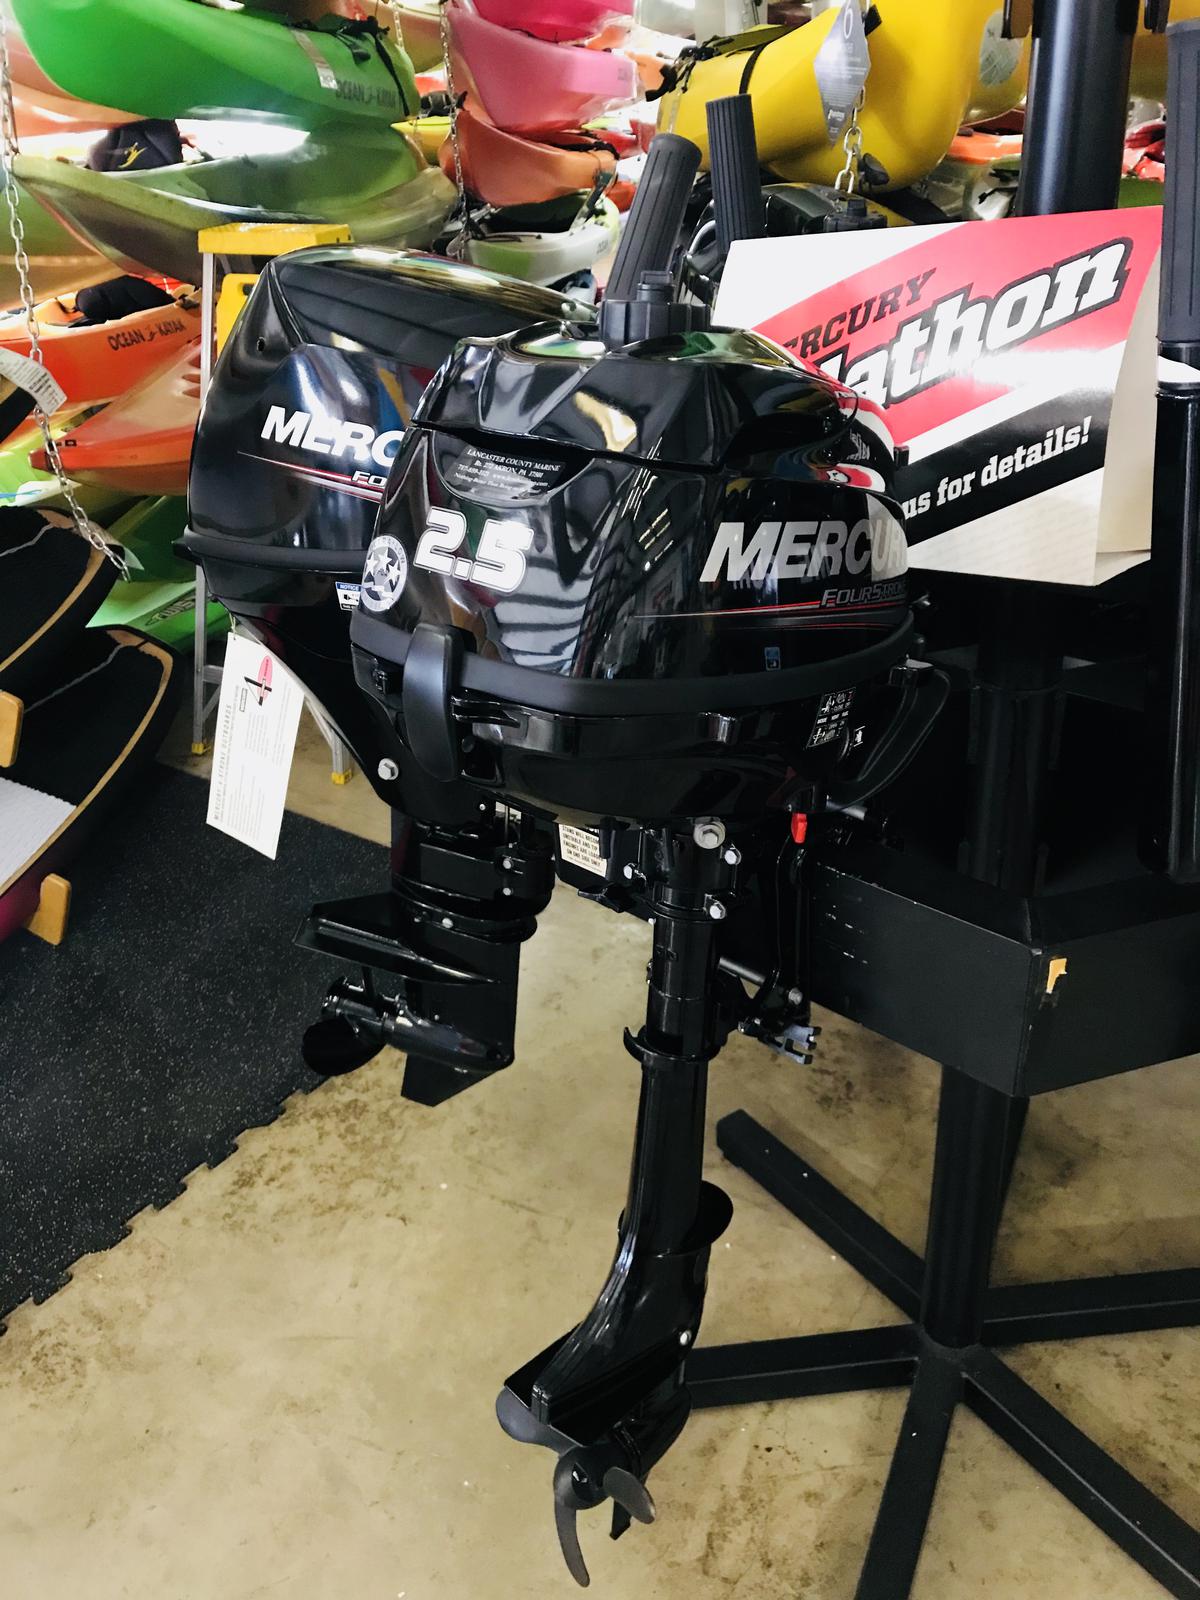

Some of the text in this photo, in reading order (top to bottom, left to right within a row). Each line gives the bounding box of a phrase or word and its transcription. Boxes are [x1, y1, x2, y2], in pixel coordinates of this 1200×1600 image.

[107, 328, 146, 351] OCEAN
[783, 267, 937, 358] RCURY
[467, 449, 561, 472] LANCASTER COUNTY MARINE
[901, 415, 1092, 520] us for details!
[413, 505, 535, 593] 2.5
